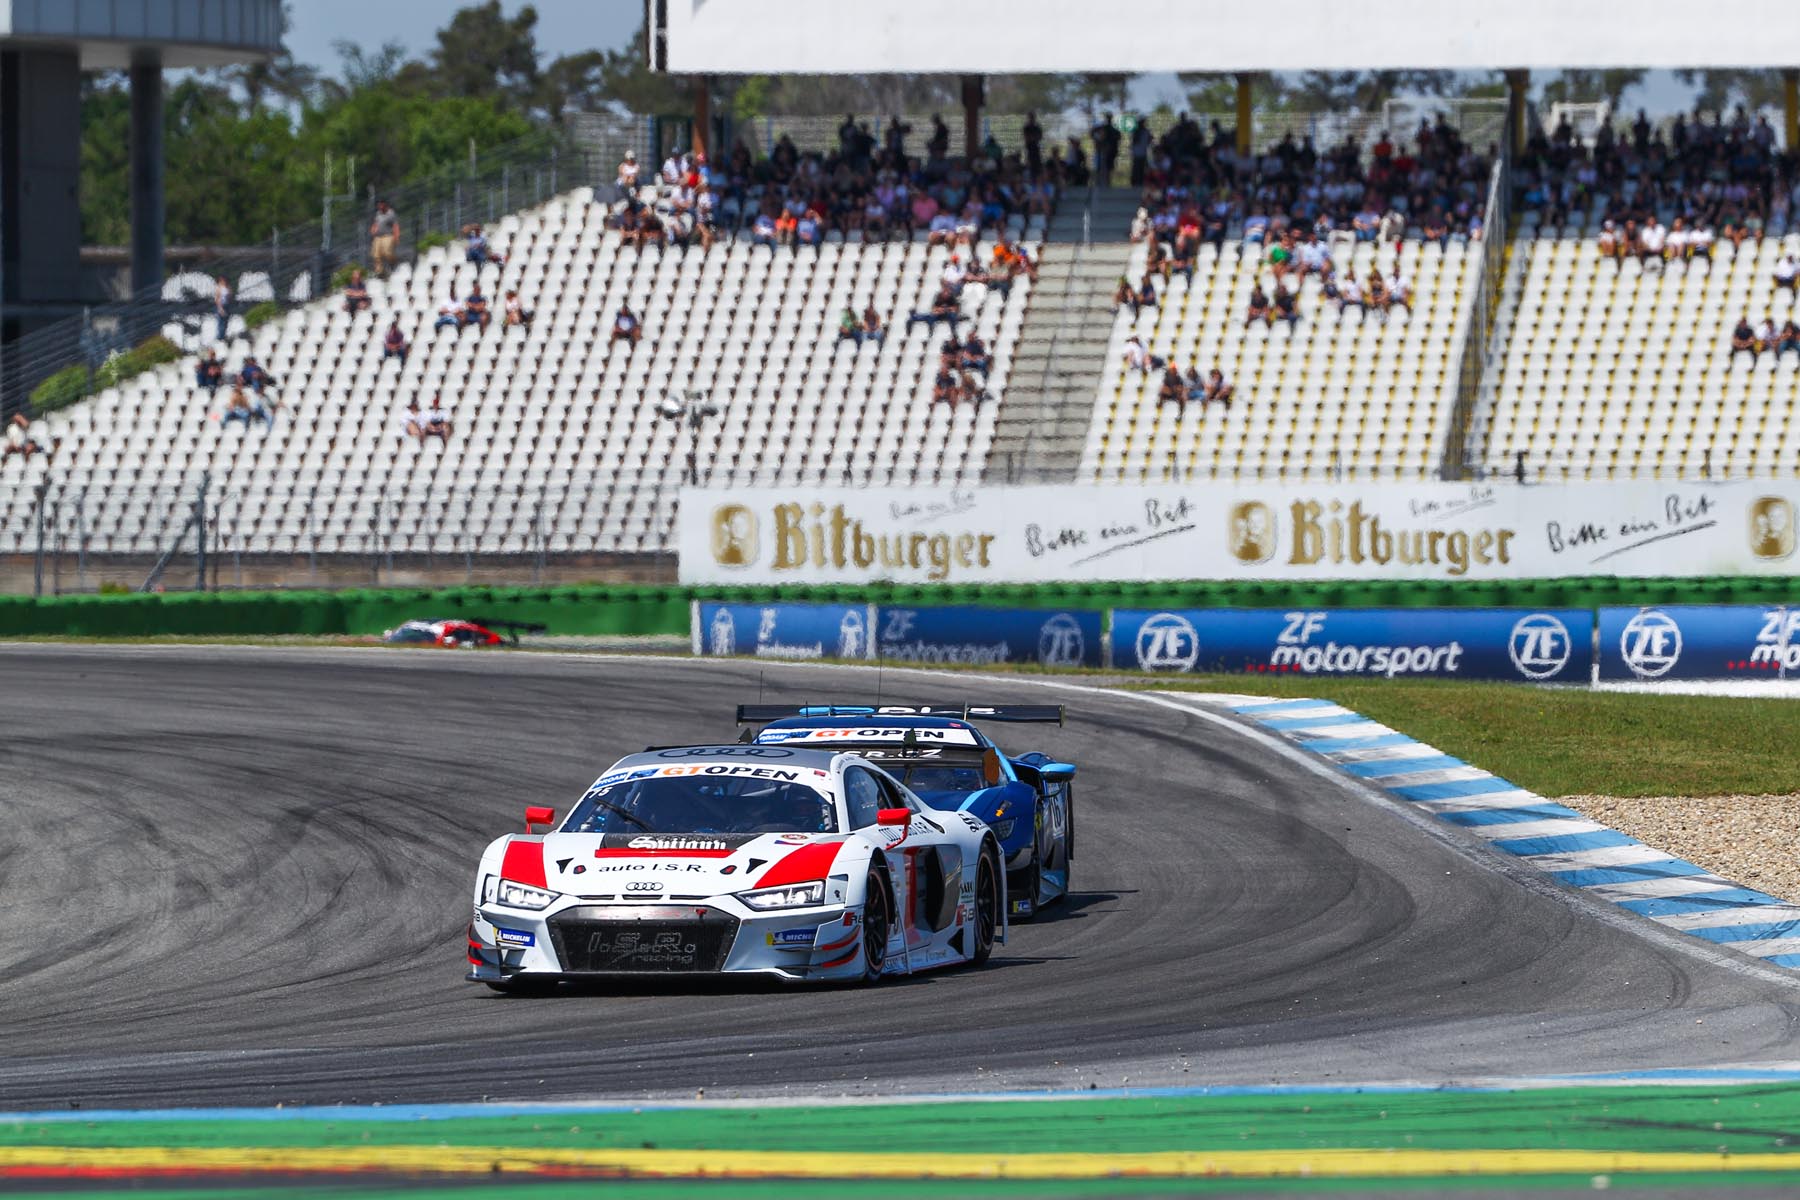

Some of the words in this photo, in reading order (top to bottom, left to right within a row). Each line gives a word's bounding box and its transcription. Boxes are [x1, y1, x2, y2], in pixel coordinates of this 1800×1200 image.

[772, 501, 997, 580] Bitburger
[1288, 498, 1517, 576] Bitburger
[1276, 612, 1328, 644] ZF
[1271, 641, 1463, 678] motorsport
[588, 786, 613, 799] 75
[599, 864, 645, 873] auto
[652, 863, 707, 873] I.S.R.
[503, 932, 531, 943] MICHELIN
[785, 933, 816, 941] MICHE
